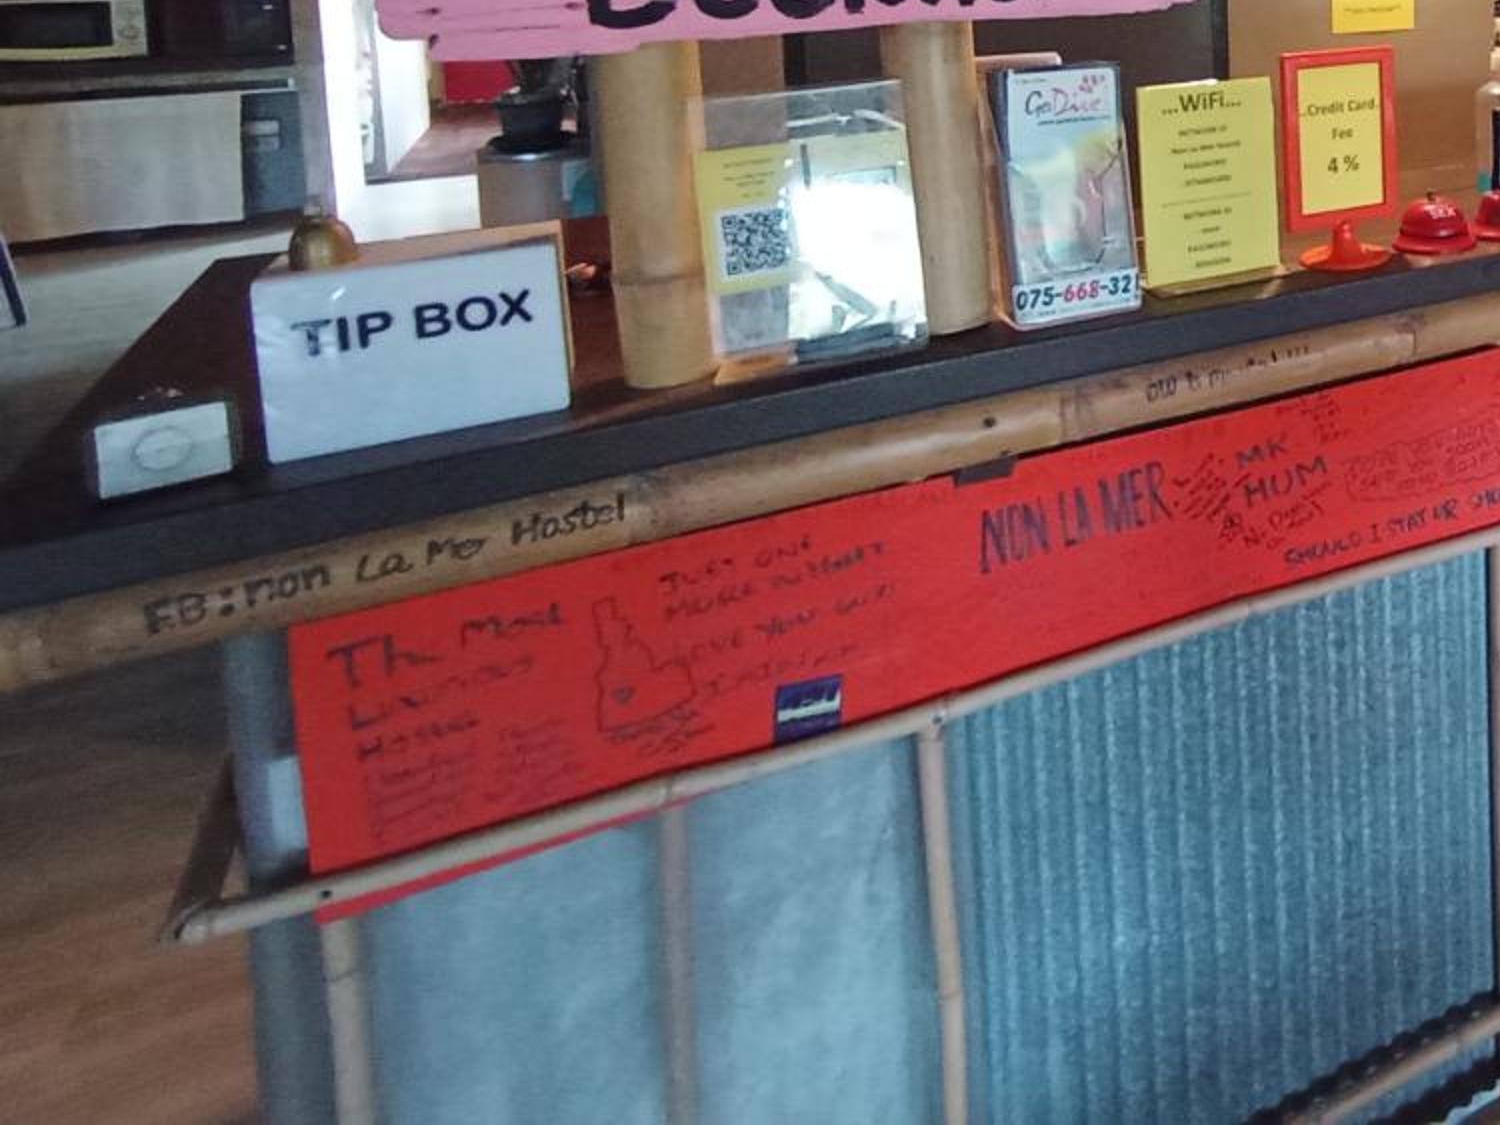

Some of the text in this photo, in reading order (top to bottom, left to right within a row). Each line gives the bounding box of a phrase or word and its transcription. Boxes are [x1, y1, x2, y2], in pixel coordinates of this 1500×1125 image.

[1327, 154, 1360, 174] 4 %
[291, 288, 533, 357] TIP BOX
[980, 492, 1052, 574] NON
[1098, 460, 1173, 535] MER
